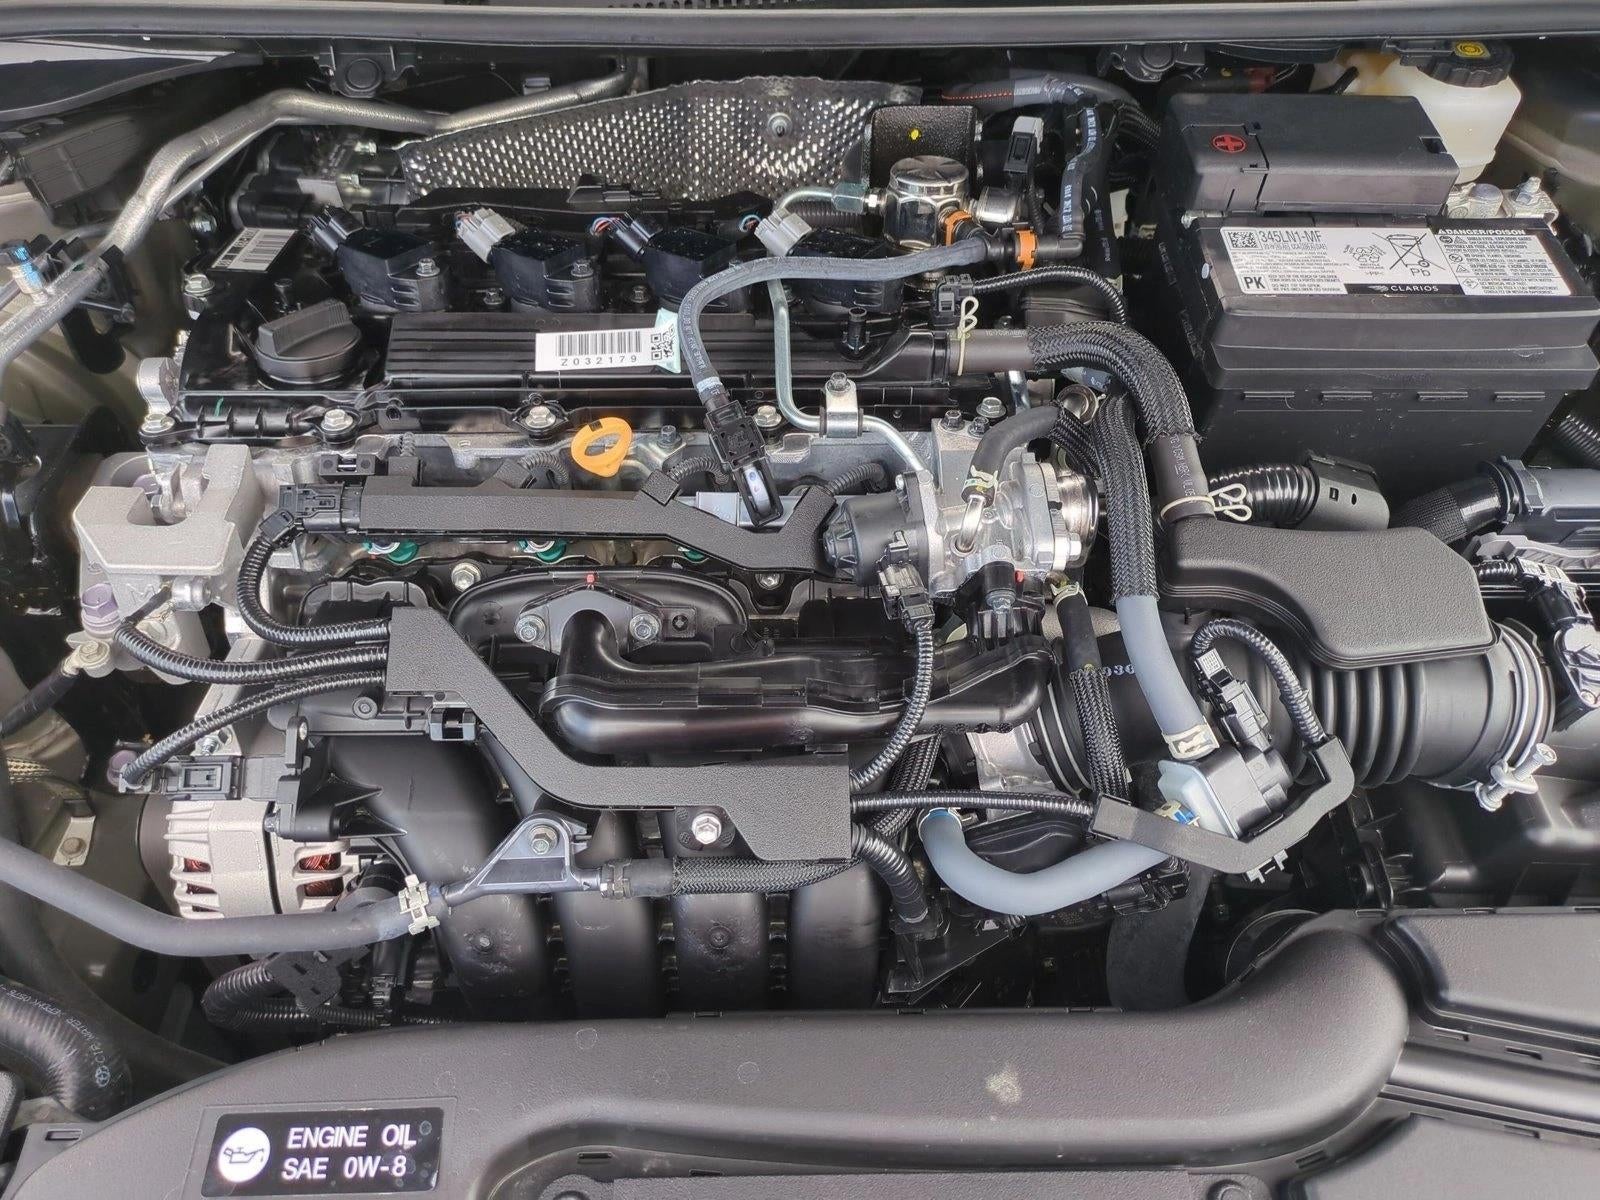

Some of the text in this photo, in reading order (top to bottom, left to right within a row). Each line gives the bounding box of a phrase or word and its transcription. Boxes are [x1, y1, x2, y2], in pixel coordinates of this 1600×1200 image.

[1259, 230, 1322, 243] 345LN1-MF
[1410, 267, 1431, 277] Pb
[1243, 276, 1266, 289] PK
[561, 355, 637, 367] Z032179
[286, 1124, 417, 1149] ENGINE OIL
[281, 1155, 407, 1181] SAE 0W-8
